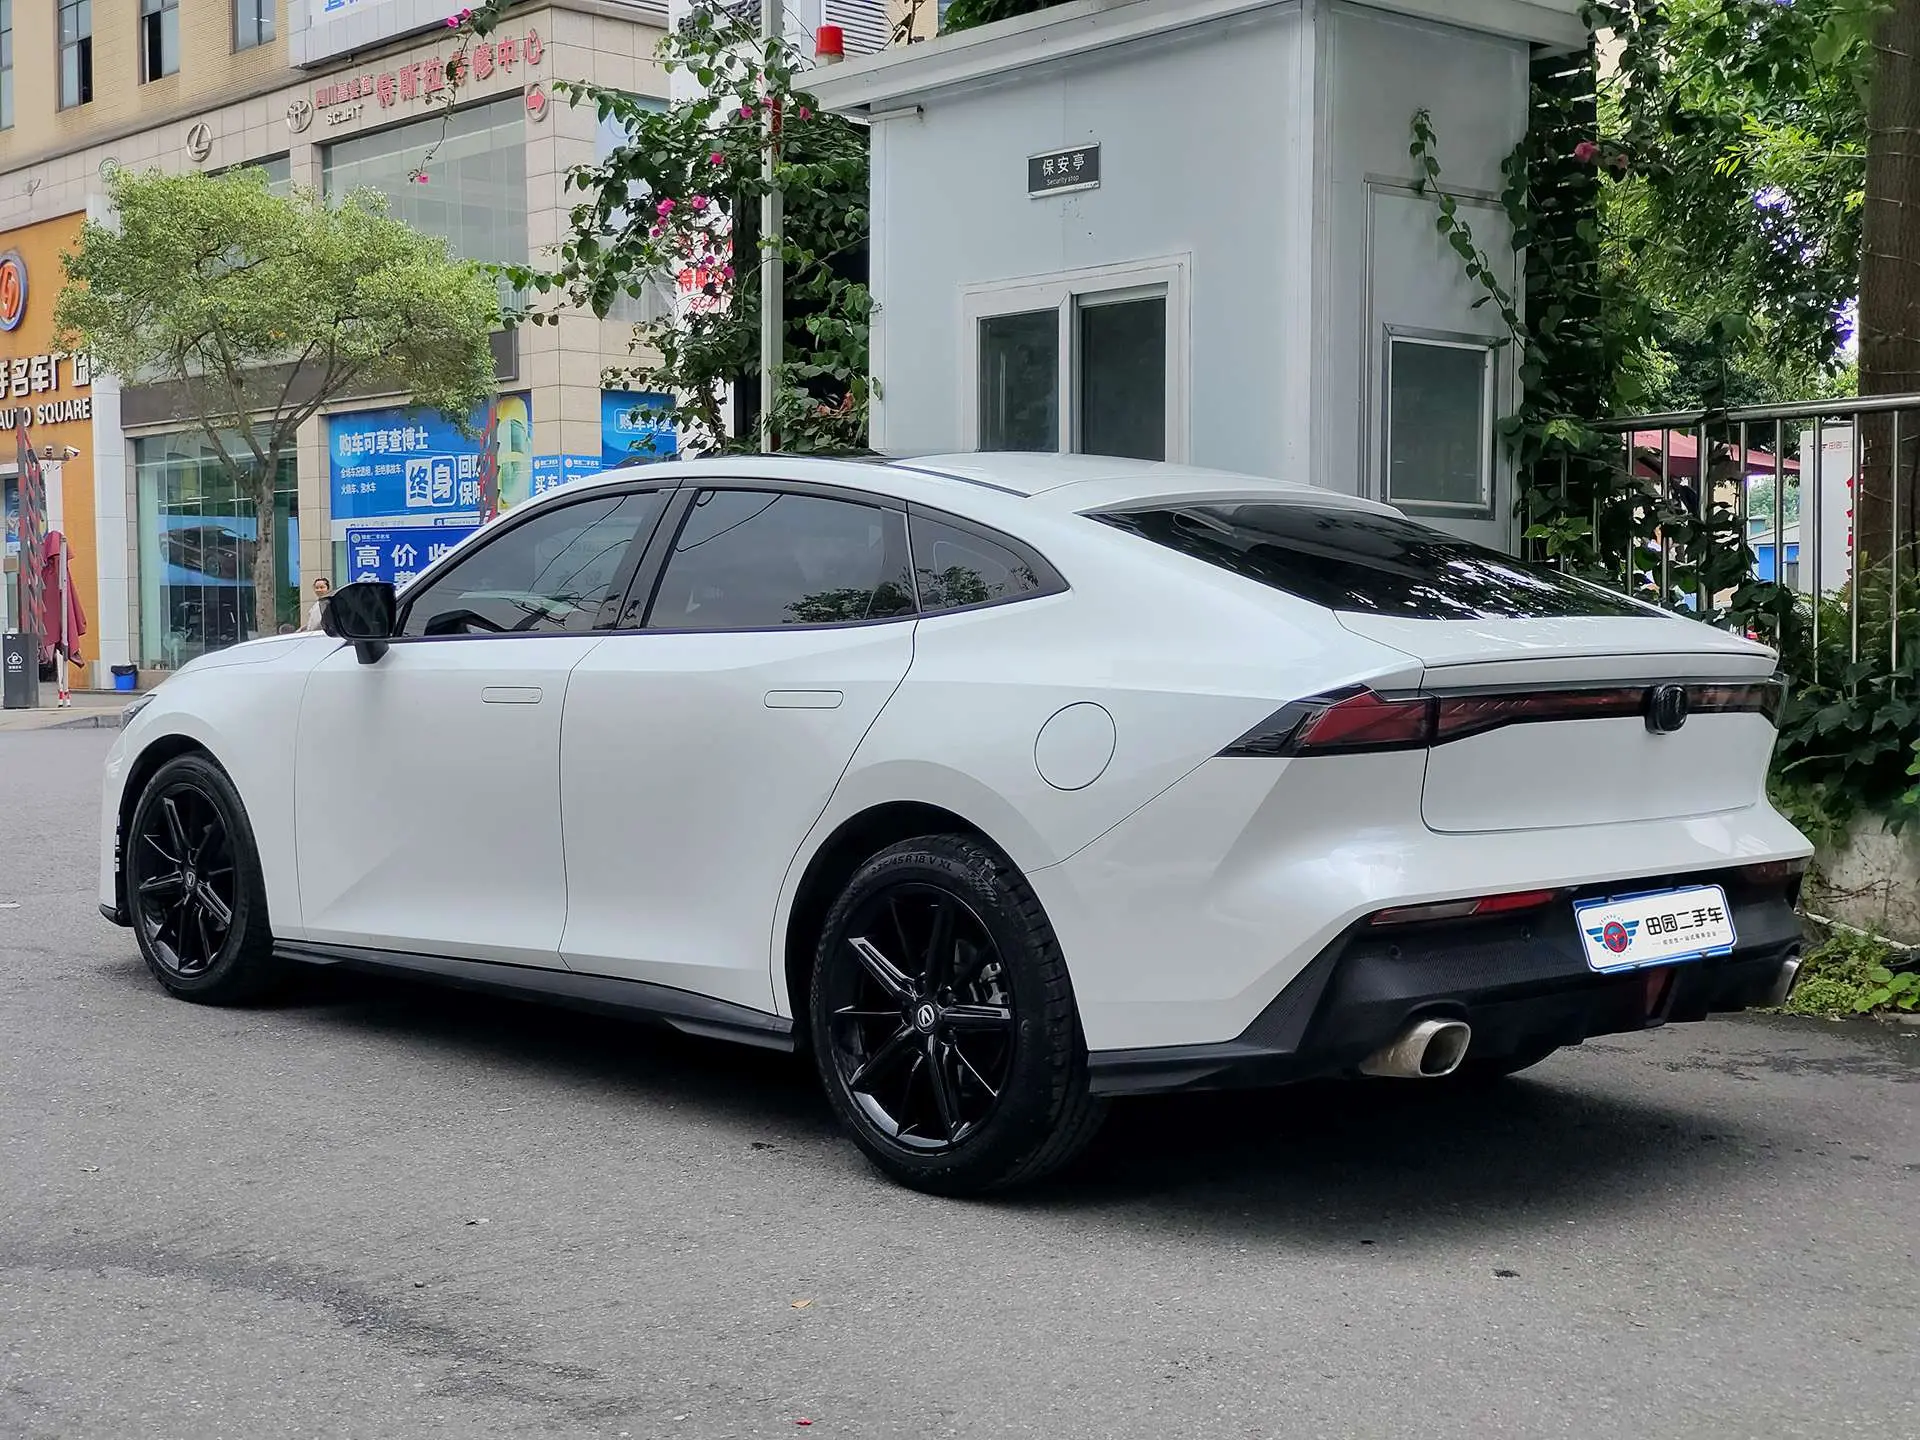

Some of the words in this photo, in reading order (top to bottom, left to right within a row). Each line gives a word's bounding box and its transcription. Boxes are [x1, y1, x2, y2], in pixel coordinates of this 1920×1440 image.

[1042, 153, 1085, 177] 保安亭
[0, 405, 32, 430] AUO
[37, 397, 92, 425] SQUARE
[338, 426, 430, 457] 购车可享查博士
[409, 463, 453, 500] 终身
[1645, 906, 1724, 936] 田园二手车
